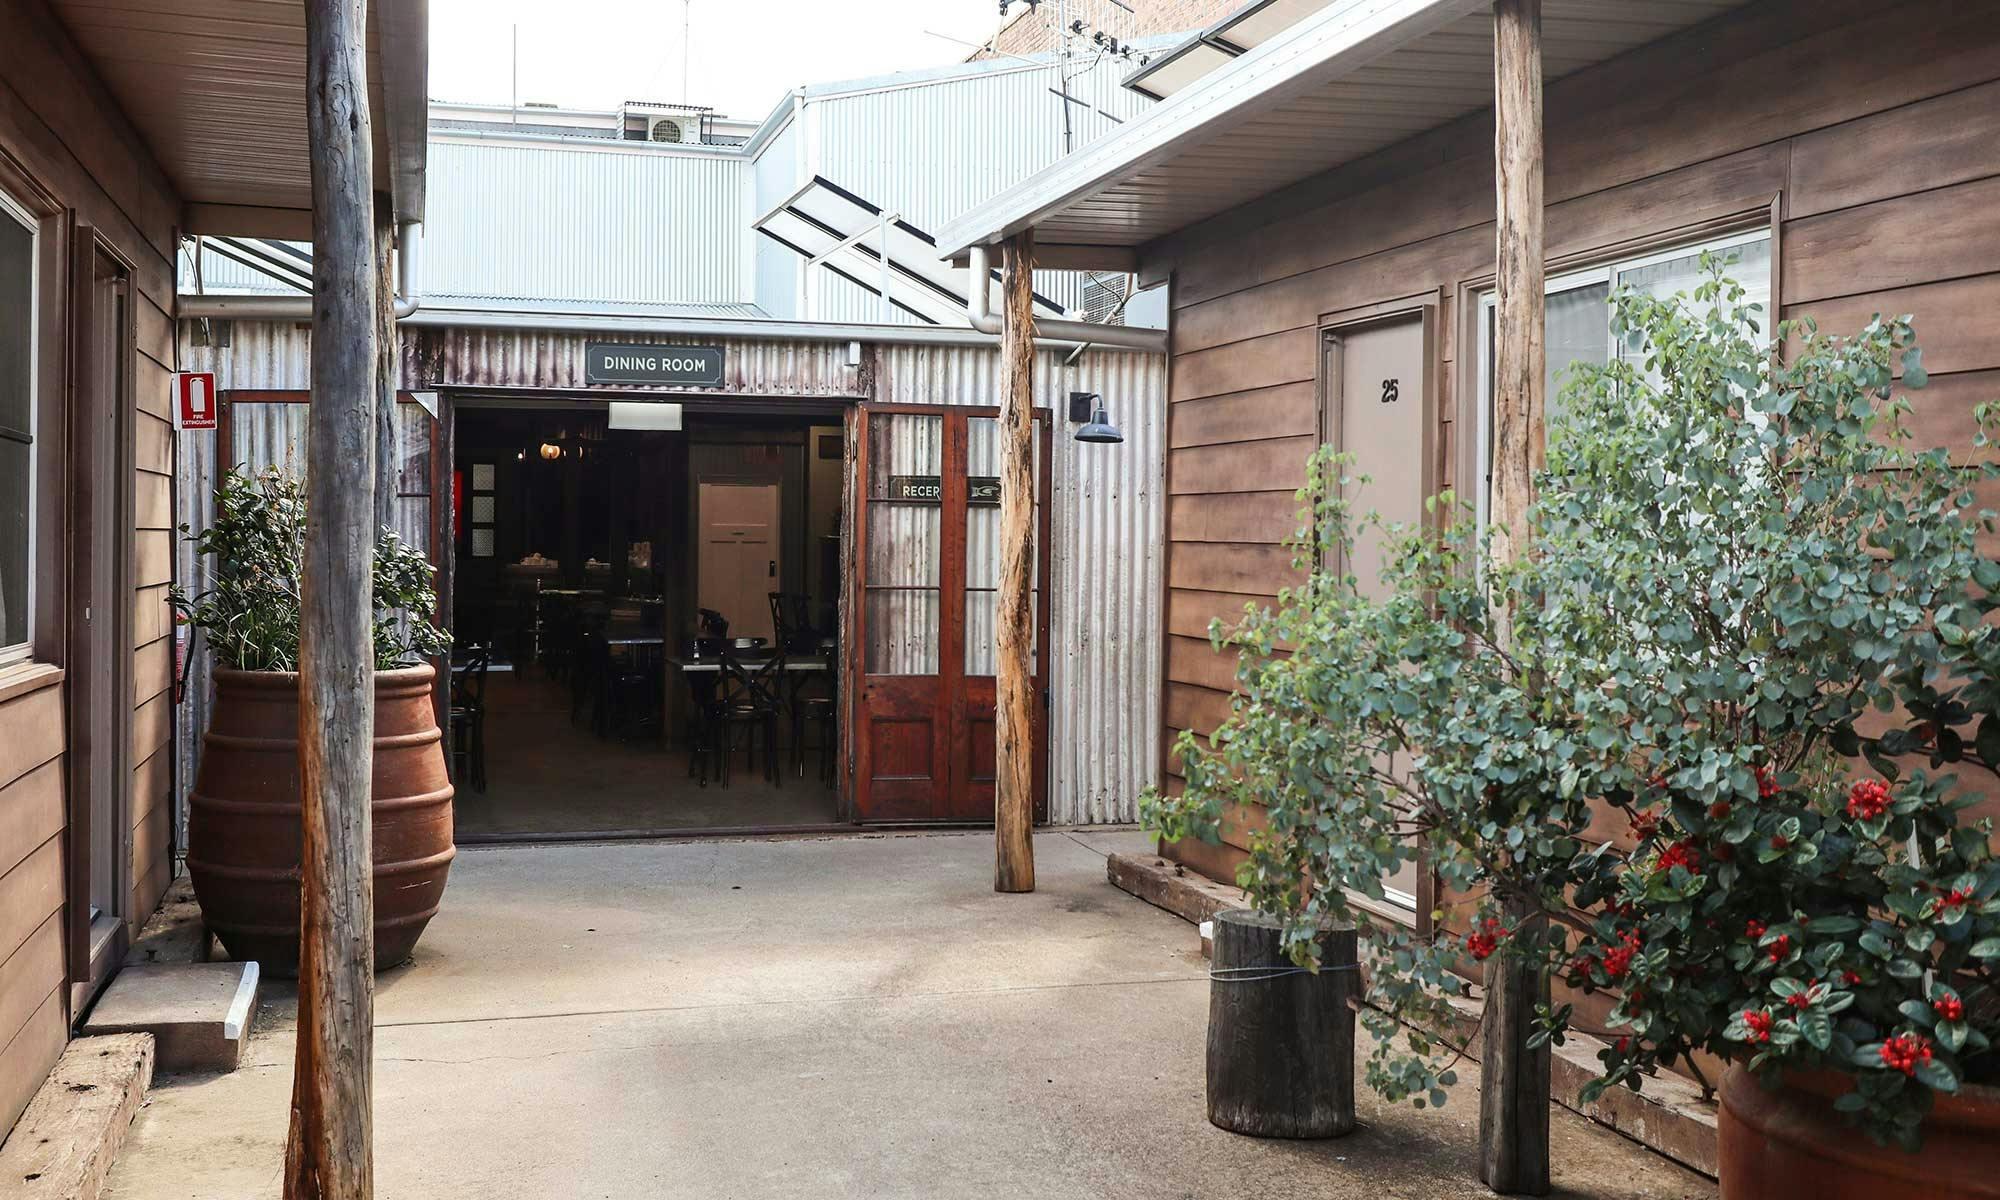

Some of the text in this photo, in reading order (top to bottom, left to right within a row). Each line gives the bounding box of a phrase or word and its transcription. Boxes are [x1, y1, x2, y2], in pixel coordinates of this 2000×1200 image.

[604, 356, 706, 372] DINING ROOM
[1381, 378, 1399, 403] 25
